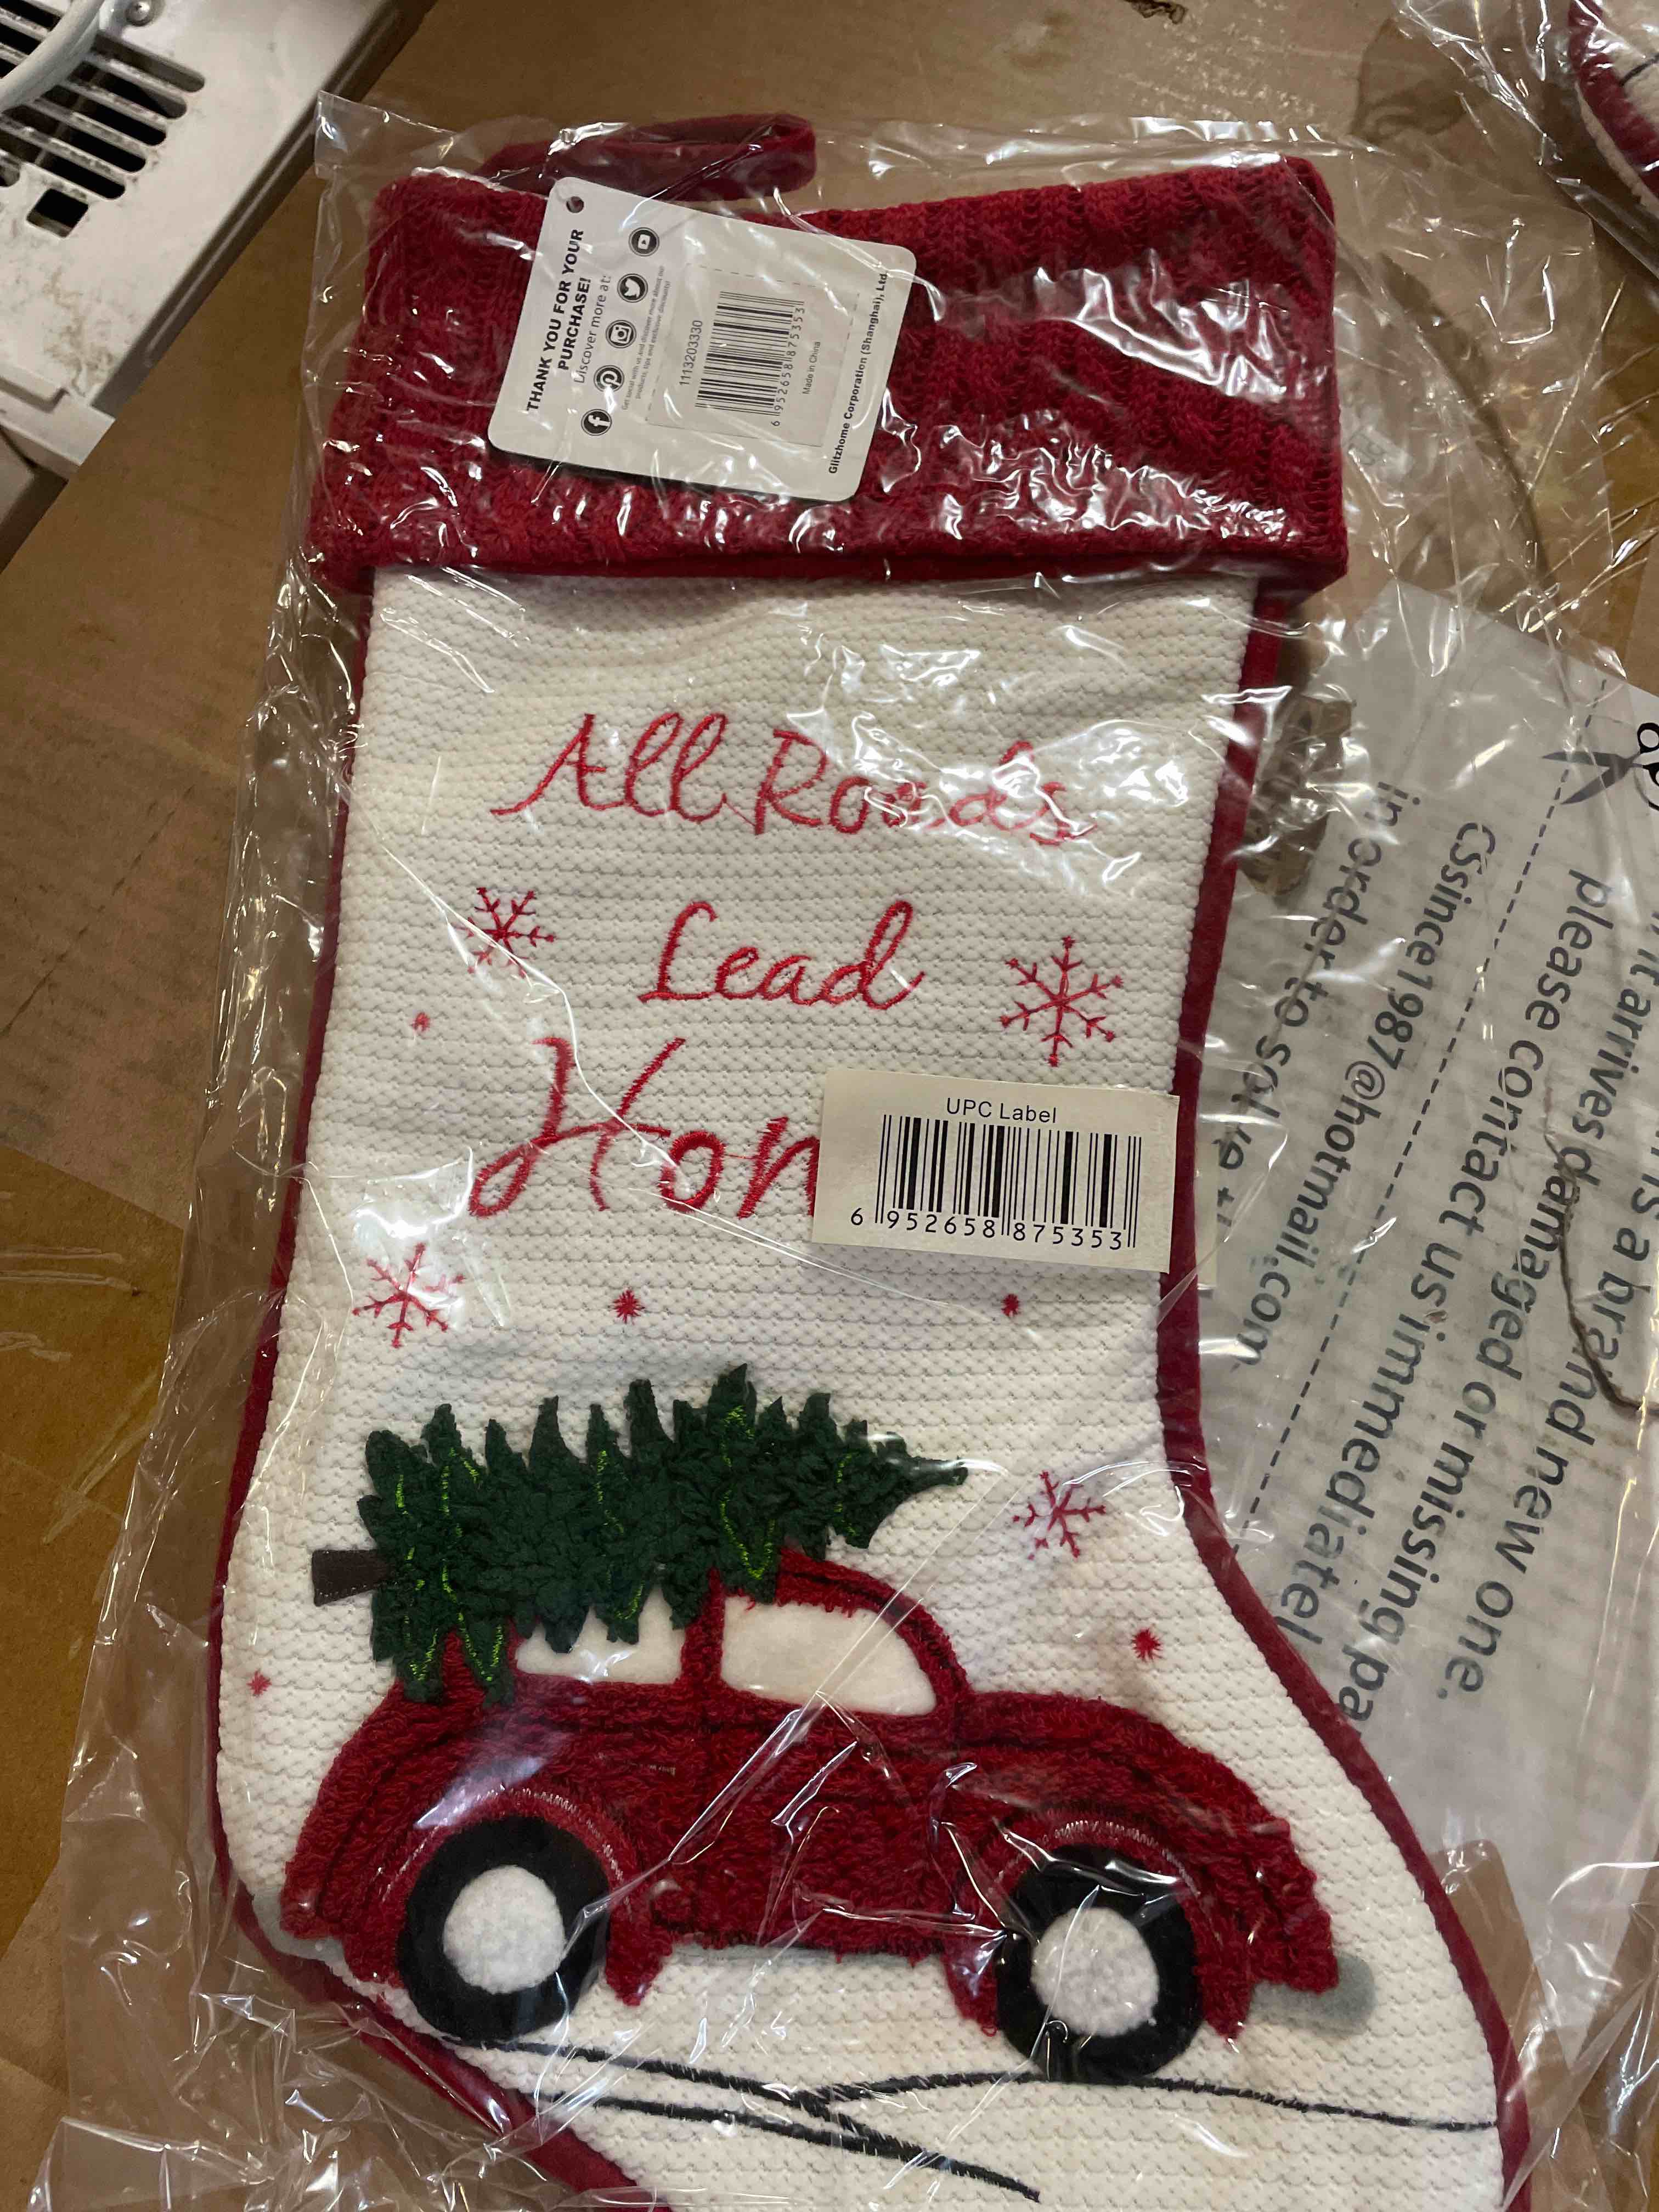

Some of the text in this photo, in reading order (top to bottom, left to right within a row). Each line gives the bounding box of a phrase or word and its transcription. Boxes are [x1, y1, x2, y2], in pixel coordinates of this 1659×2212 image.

[527, 229, 584, 411] THANK YOU FOR YOUR
[557, 277, 591, 370] PURCHASE!
[574, 275, 611, 383] Discover more at:
[679, 320, 703, 386] 1113203330
[774, 364, 793, 411] 952658
[786, 307, 805, 357] 875353
[802, 341, 821, 394] Made in China
[828, 422, 850, 474] Glitzhome
[844, 357, 867, 420] Corporation
[860, 294, 885, 355] (Shanghai),
[490, 711, 728, 823] All
[1364, 781, 1420, 827] in
[639, 900, 925, 1011] Lead
[1304, 838, 1382, 970] order
[1274, 977, 1329, 1027] to
[946, 1097, 1057, 1124] UPC Label
[1572, 988, 1651, 1140] arrives
[850, 1207, 1122, 1251] 6 952658 875353
[1276, 869, 1614, 1646] please contact us immediatel
[1475, 1146, 1600, 1380] damaged
[1613, 1228, 1650, 1261] a
[1454, 1380, 1497, 1441] or
[1545, 1270, 1651, 1445] brand
[1358, 1441, 1476, 1645] missing
[1495, 1446, 1568, 1573] new
[1339, 1644, 1390, 1728] pa
[1437, 1579, 1514, 1701] one.
